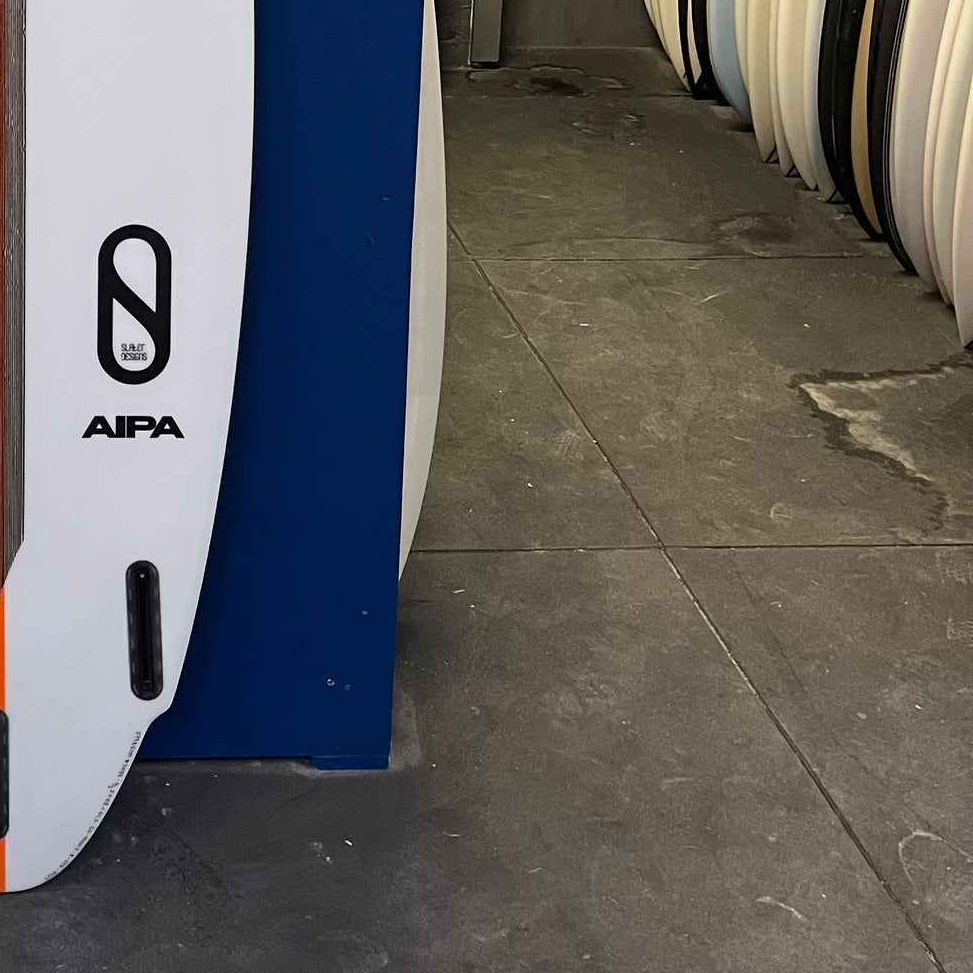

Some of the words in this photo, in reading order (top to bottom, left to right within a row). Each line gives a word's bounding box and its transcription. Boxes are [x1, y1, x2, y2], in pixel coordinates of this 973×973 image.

[121, 343, 146, 352] SLATER
[120, 352, 148, 361] DESIGNS
[81, 416, 185, 439] AIPA
